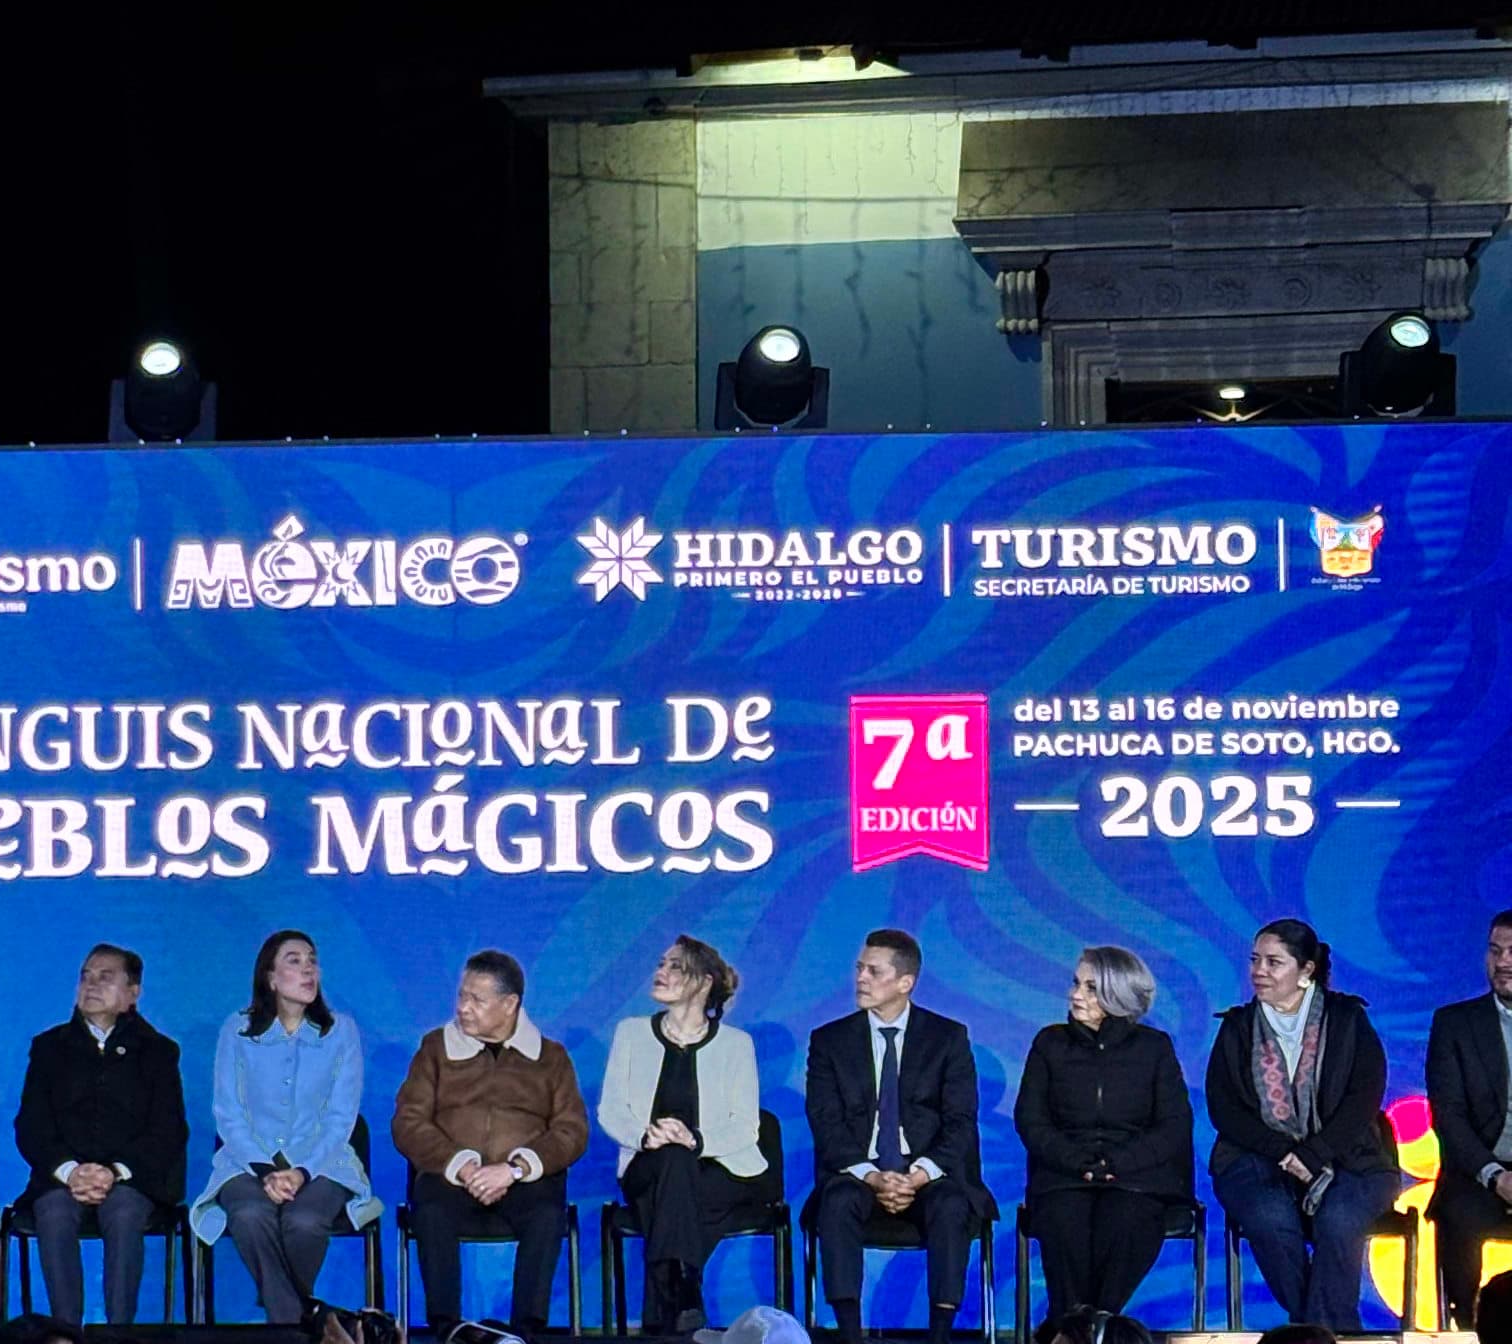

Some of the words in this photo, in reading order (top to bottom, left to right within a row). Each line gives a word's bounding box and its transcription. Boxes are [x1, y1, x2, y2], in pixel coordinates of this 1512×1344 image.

[672, 529, 923, 568] HIDALGO
[971, 524, 1257, 569] TURISMO
[673, 570, 782, 588] PRIMERO
[791, 570, 819, 586] EL
[827, 568, 923, 585] PUEBLO
[973, 574, 1109, 597] SECRETARÍA
[1112, 576, 1145, 595] DE
[1146, 574, 1251, 594] TURISMO
[1013, 698, 1062, 722] del
[1069, 698, 1101, 722] 13
[1107, 696, 1135, 721] al
[1143, 695, 1176, 721] 16
[1182, 695, 1223, 721] de
[1231, 693, 1400, 720] noviembre
[1013, 732, 1164, 757] PACHUCA
[1171, 732, 1214, 755] DE
[1221, 730, 1315, 759] SOTO,
[1322, 728, 1402, 755] HGO.
[1099, 771, 1316, 838] 2025
